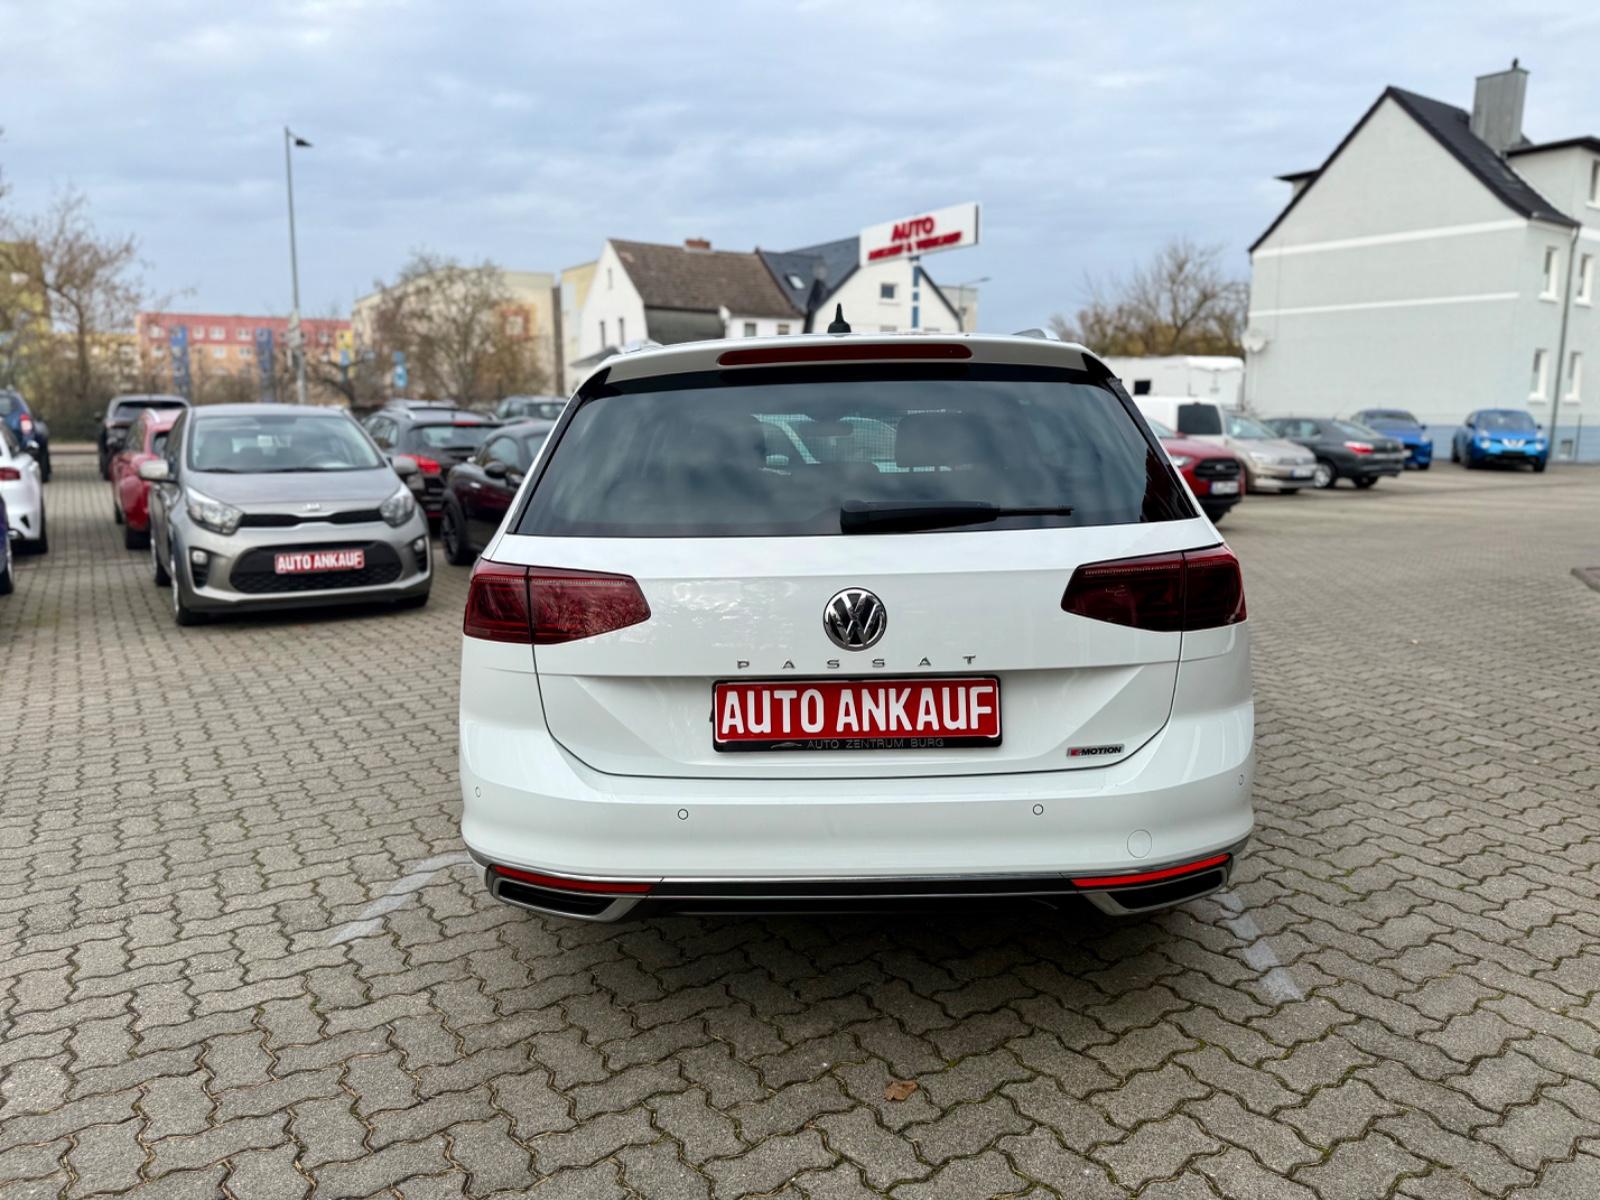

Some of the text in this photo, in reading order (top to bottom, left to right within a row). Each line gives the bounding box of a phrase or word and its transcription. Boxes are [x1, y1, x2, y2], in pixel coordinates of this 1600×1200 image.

[891, 217, 934, 242] AUTO
[278, 550, 363, 571] AUTO ANKAUF
[737, 655, 976, 670] PASSAT
[721, 686, 994, 734] AUTO ANKAUF
[807, 738, 945, 749] AUTO ZENTRUM BURG
